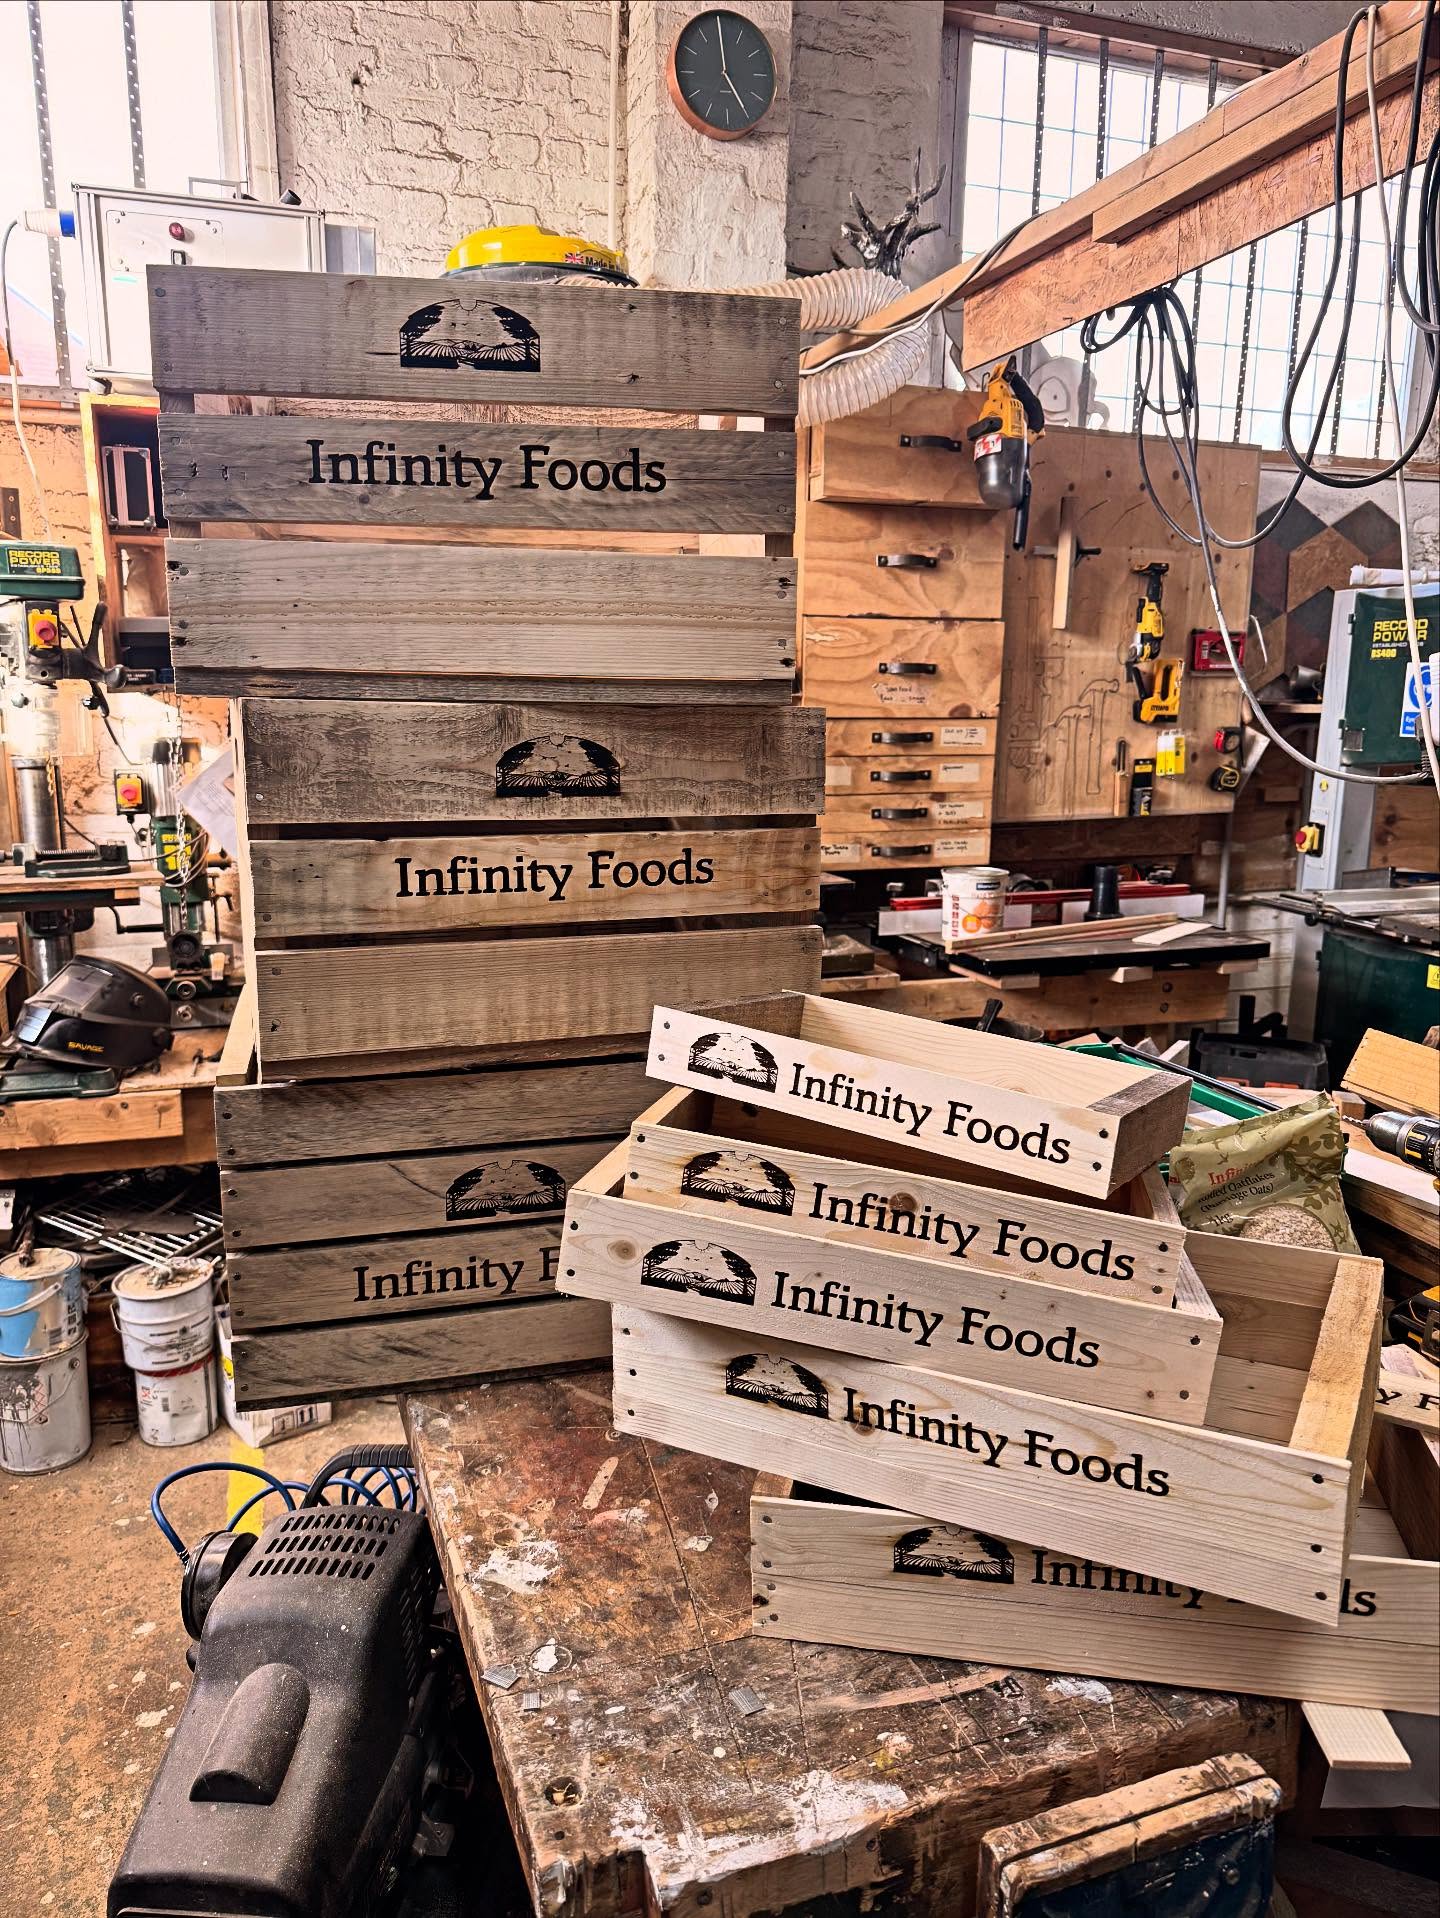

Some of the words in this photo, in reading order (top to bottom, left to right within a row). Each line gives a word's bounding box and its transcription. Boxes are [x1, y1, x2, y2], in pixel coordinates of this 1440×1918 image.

[585, 256, 608, 268] Made
[306, 440, 502, 500] Infinity
[519, 445, 667, 494] Foods
[9, 550, 60, 559] RECORD
[9, 557, 61, 566] POWER
[1373, 618, 1429, 632] RECOD
[1372, 629, 1428, 642] POWR
[395, 855, 573, 902] Infinity
[588, 848, 714, 889] Foods
[68, 1041, 104, 1053] SAVAGE
[789, 1062, 932, 1138] Infinity
[943, 1100, 1071, 1164] Foods
[1227, 1172, 1276, 1192] Oatflakes
[1248, 1182, 1274, 1196] Oats)
[809, 1182, 980, 1259] Infinity
[993, 1219, 1136, 1281] Foods
[353, 1256, 525, 1302] Infinity
[770, 1271, 943, 1348] Infinity
[957, 1306, 1100, 1368] Foods
[843, 1387, 1008, 1469] Infinity
[1023, 1429, 1170, 1497] Foods
